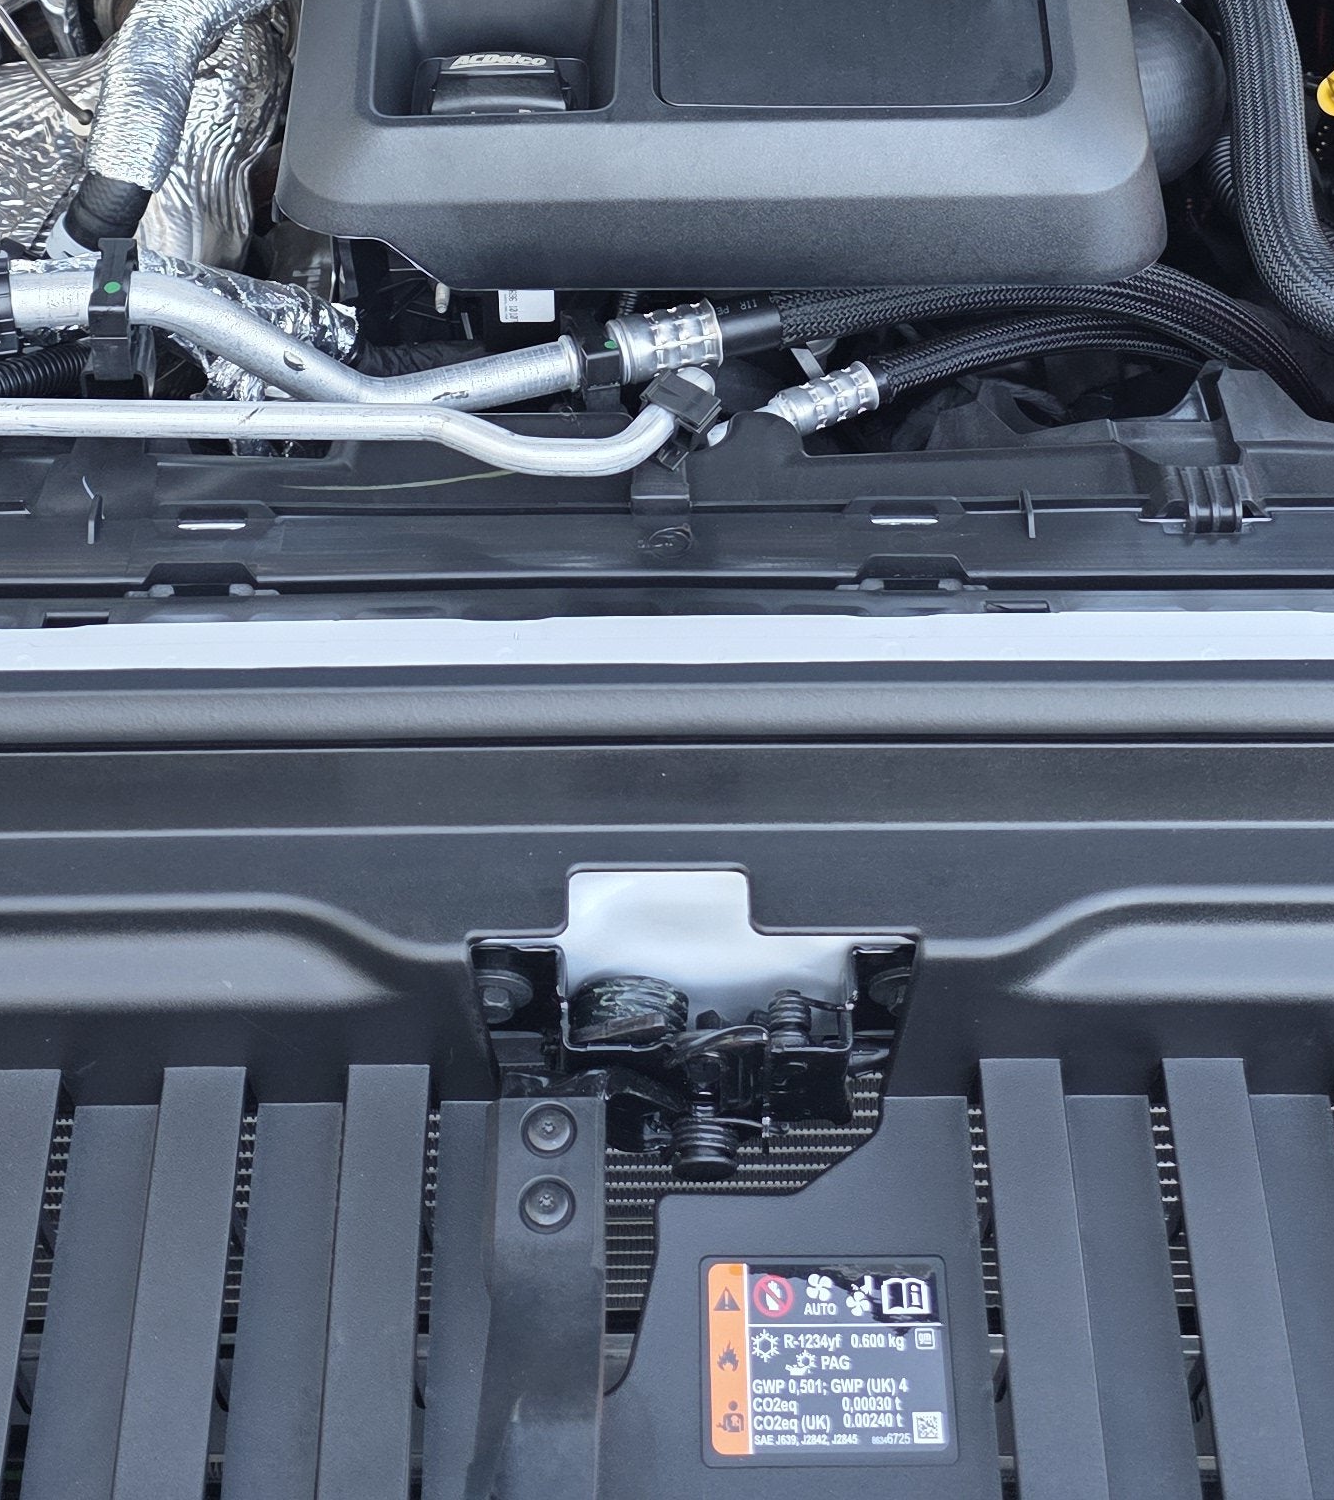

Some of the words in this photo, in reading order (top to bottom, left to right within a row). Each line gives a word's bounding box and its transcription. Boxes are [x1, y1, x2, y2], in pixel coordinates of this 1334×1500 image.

[449, 54, 547, 69] ACDelco
[804, 1303, 837, 1316] AUTO
[783, 1333, 842, 1351] R-1234yf
[851, 1333, 885, 1348] 0.600
[888, 1333, 905, 1351] kg
[821, 1356, 851, 1370] PAG
[752, 1379, 785, 1393] GWP
[788, 1379, 827, 1395] 0,501;
[831, 1378, 864, 1393] GWP
[867, 1378, 896, 1395] (UK)
[898, 1378, 908, 1393] 4
[753, 1397, 798, 1415] CO2eq
[842, 1397, 892, 1412] 0,00030
[895, 1397, 902, 1411] t
[753, 1415, 798, 1433] CO2eq
[801, 1415, 831, 1432] (UK)
[843, 1413, 893, 1428] 0.00240
[896, 1414, 904, 1428] t
[754, 1435, 774, 1445] SAE
